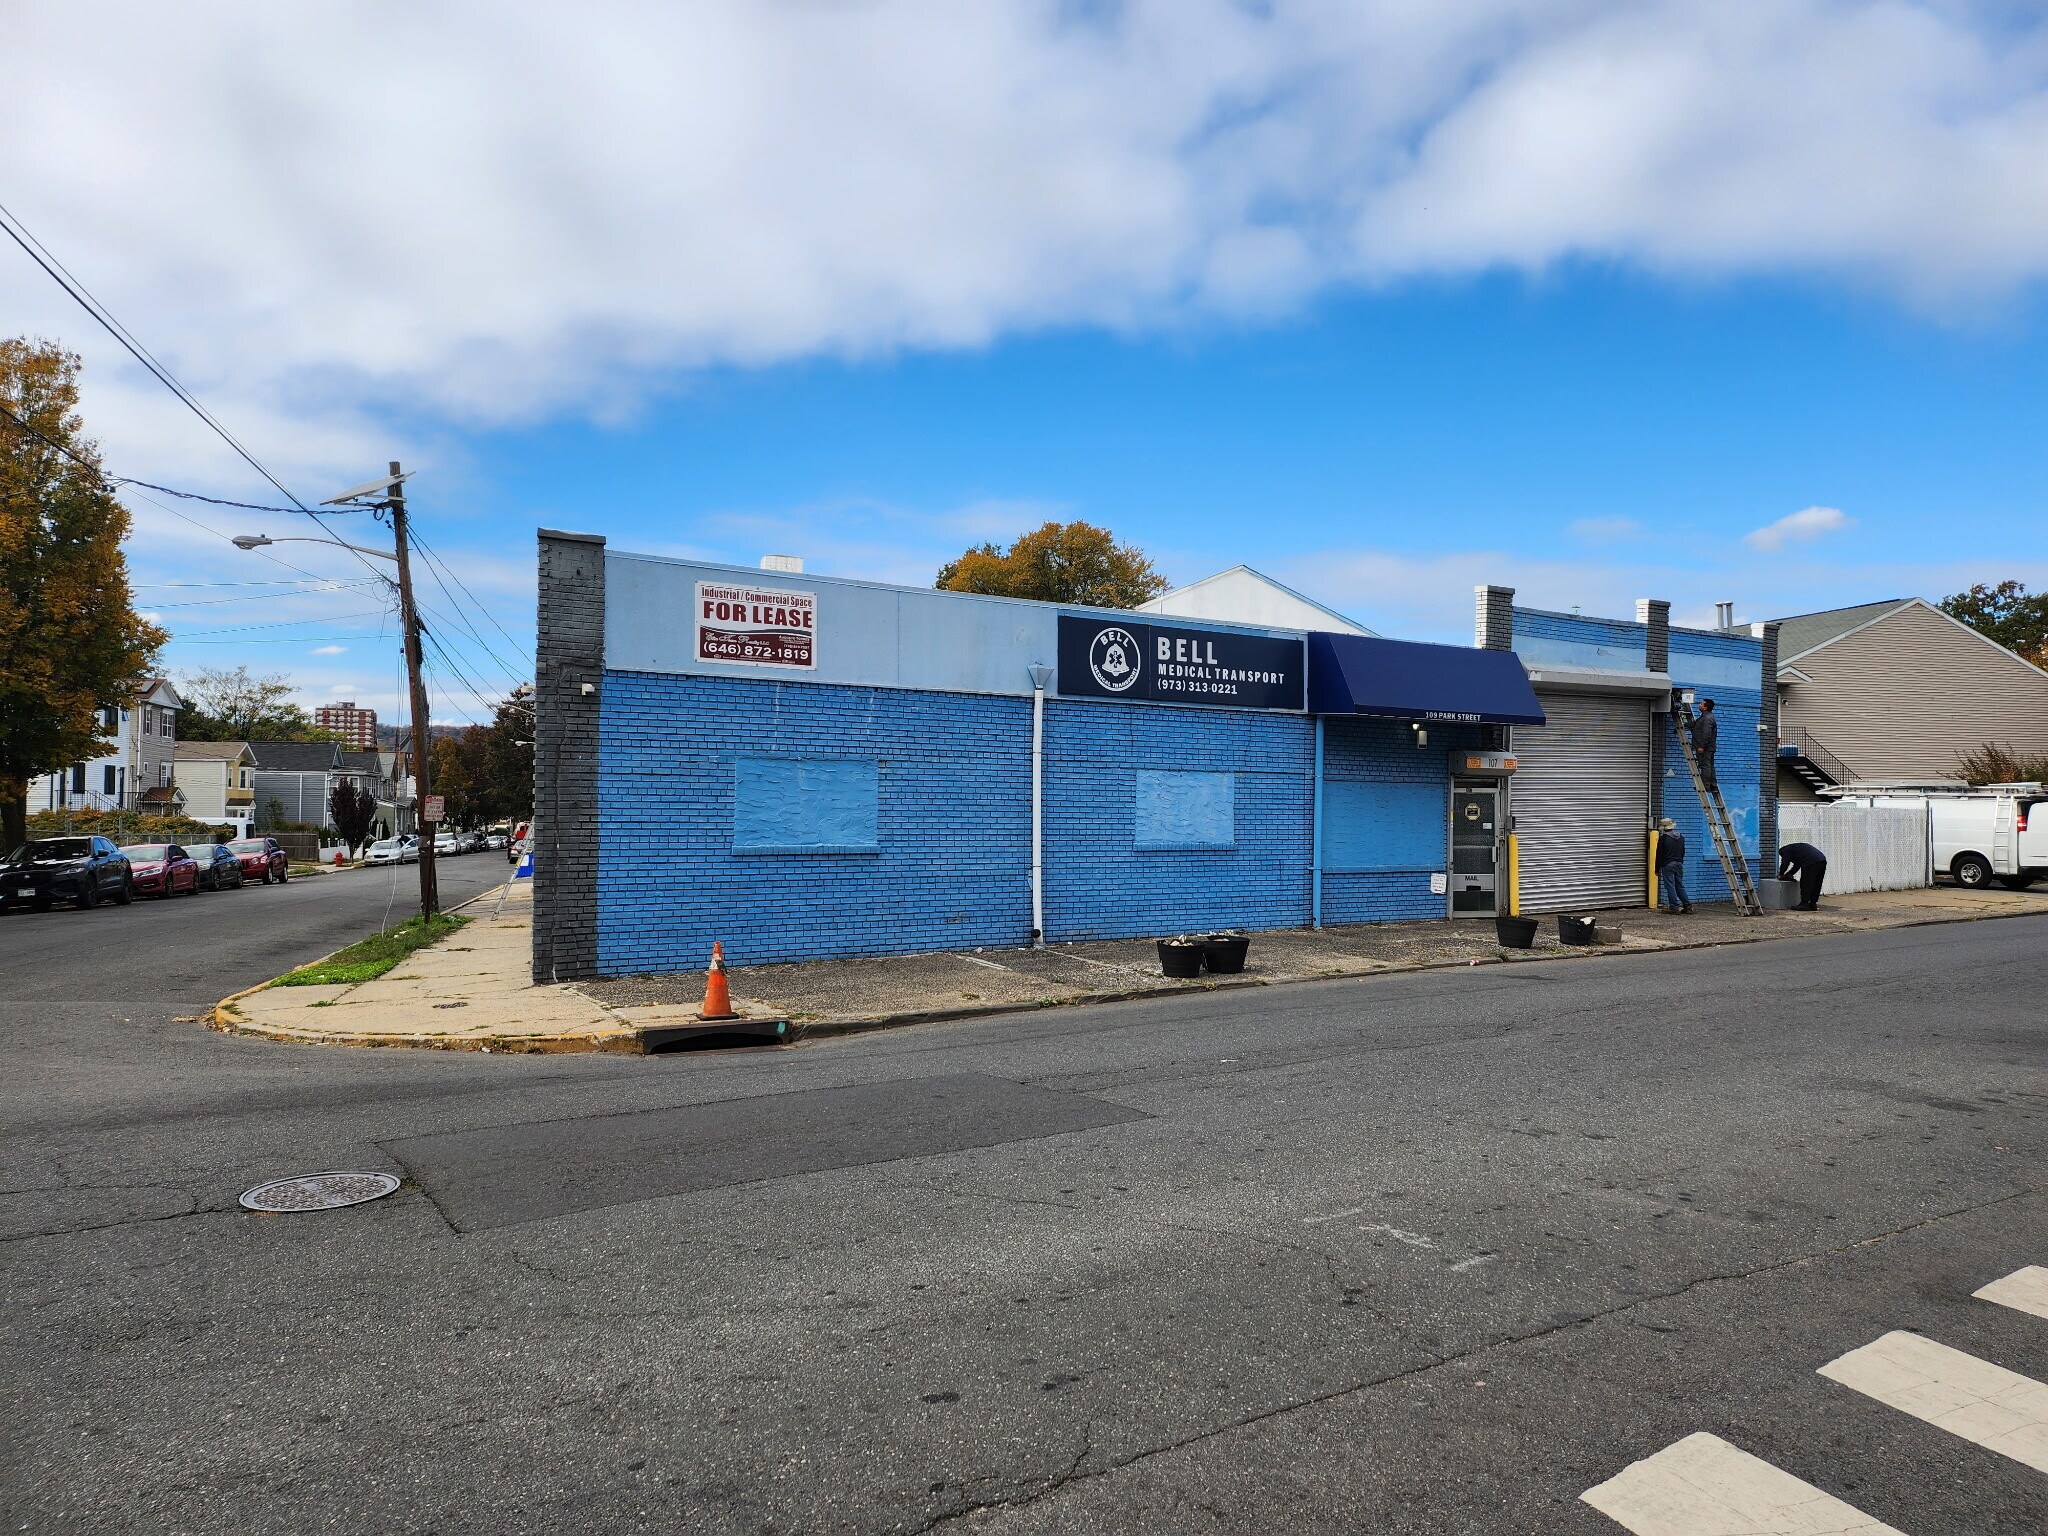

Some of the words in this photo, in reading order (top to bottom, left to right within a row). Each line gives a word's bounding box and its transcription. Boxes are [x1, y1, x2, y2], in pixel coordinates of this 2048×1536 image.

[701, 586, 740, 601] Industrial
[745, 591, 790, 606] Commercial
[790, 595, 813, 608] Space
[703, 600, 747, 623] FOR
[752, 605, 813, 629] LEASE
[1100, 631, 1129, 648] BELL
[703, 641, 741, 656] (646)
[744, 645, 809, 660] 872-1819
[1157, 636, 1218, 665] BELL
[1093, 664, 1112, 688] MEDICAL
[1158, 663, 1212, 679] MEDICAL
[1214, 668, 1285, 685] TRANSPORT
[1157, 678, 1186, 692] (973)
[1188, 681, 1238, 695] 313-0221
[1425, 711, 1438, 719] 109
[1438, 712, 1456, 720] PARK
[1457, 713, 1482, 722] STREET
[1488, 758, 1498, 768] 107
